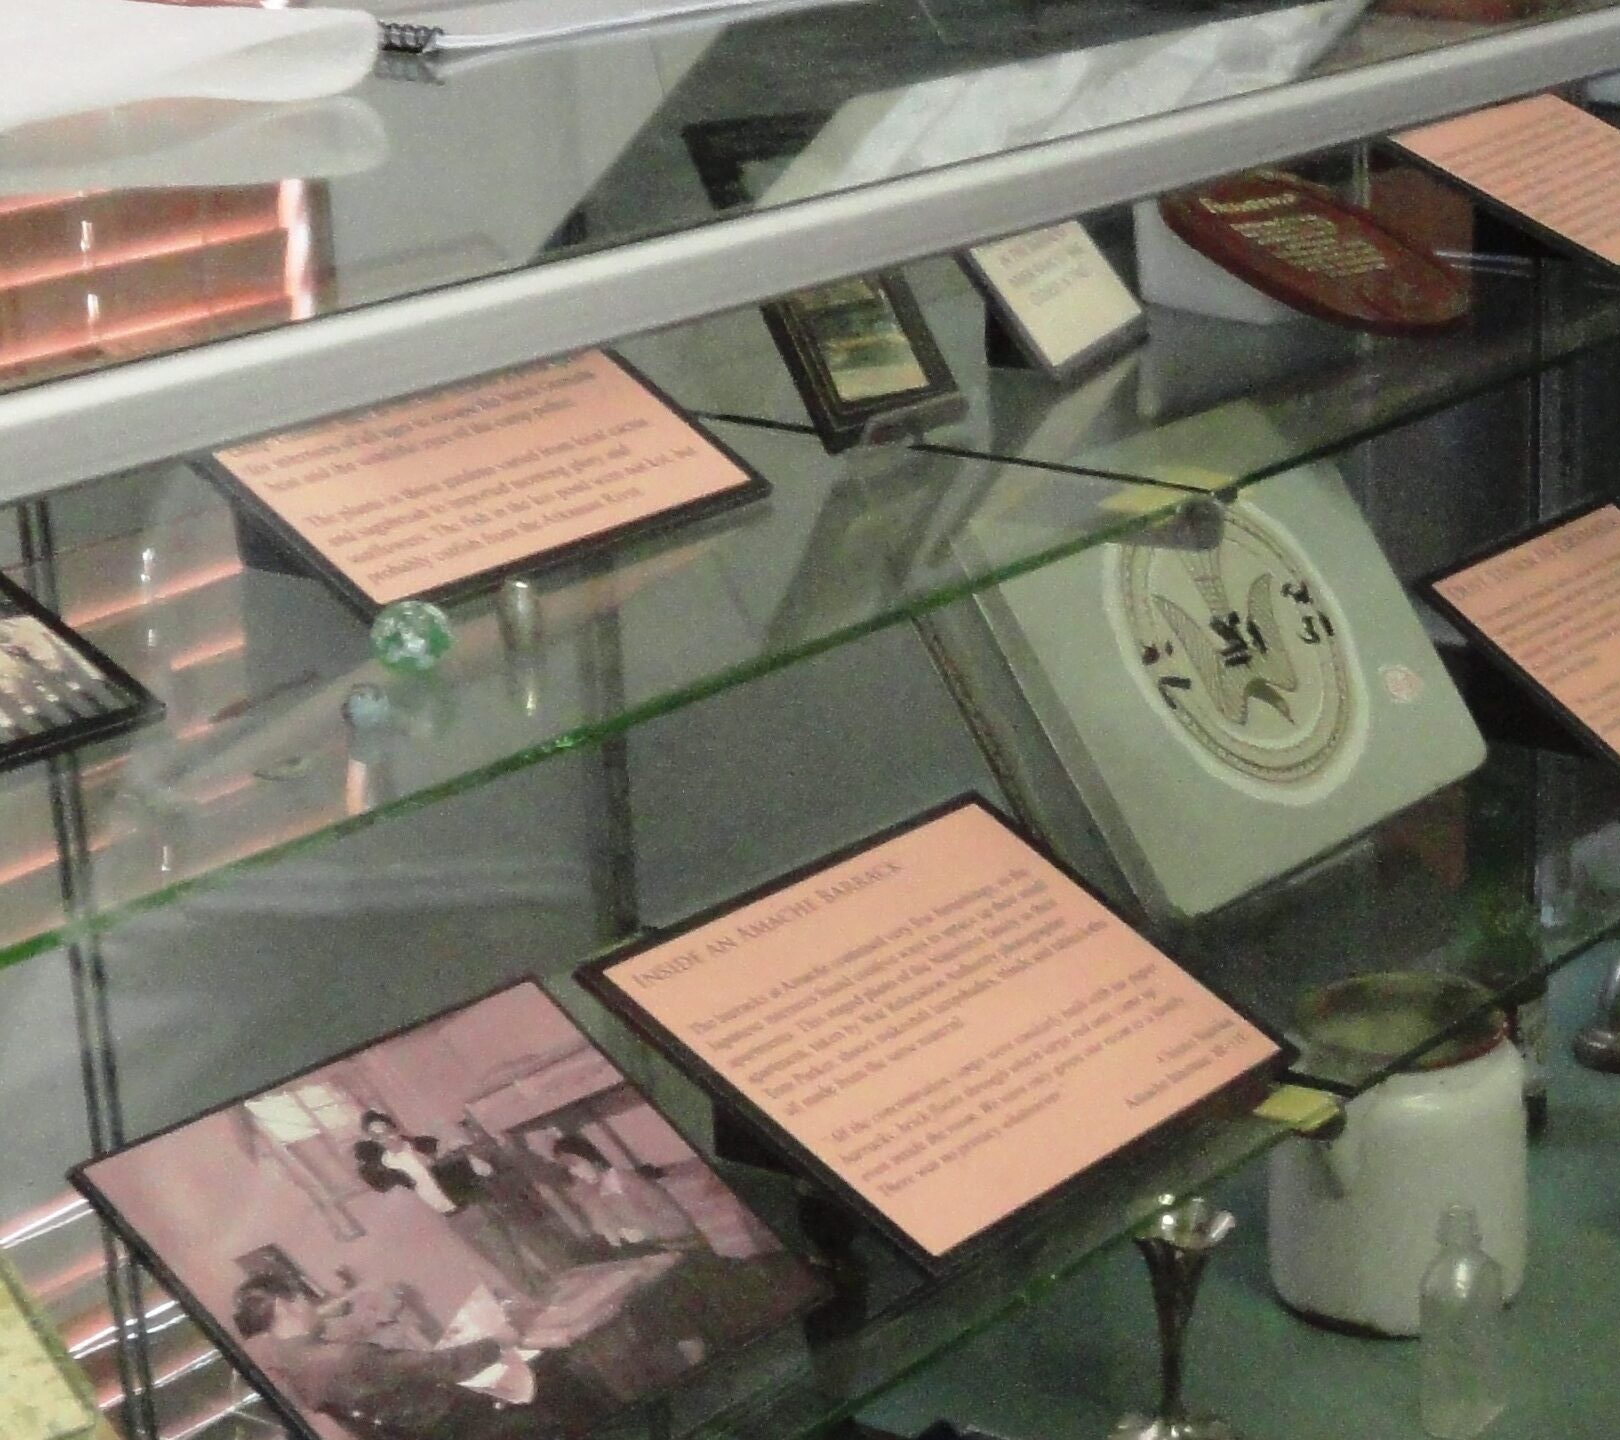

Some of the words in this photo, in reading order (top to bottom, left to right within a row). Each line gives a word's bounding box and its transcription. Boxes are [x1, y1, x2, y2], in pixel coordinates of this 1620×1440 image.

[632, 953, 700, 987] INSIDE
[706, 937, 737, 955] AN
[737, 900, 816, 939] AMACHE
[818, 862, 900, 903] BARRACK
